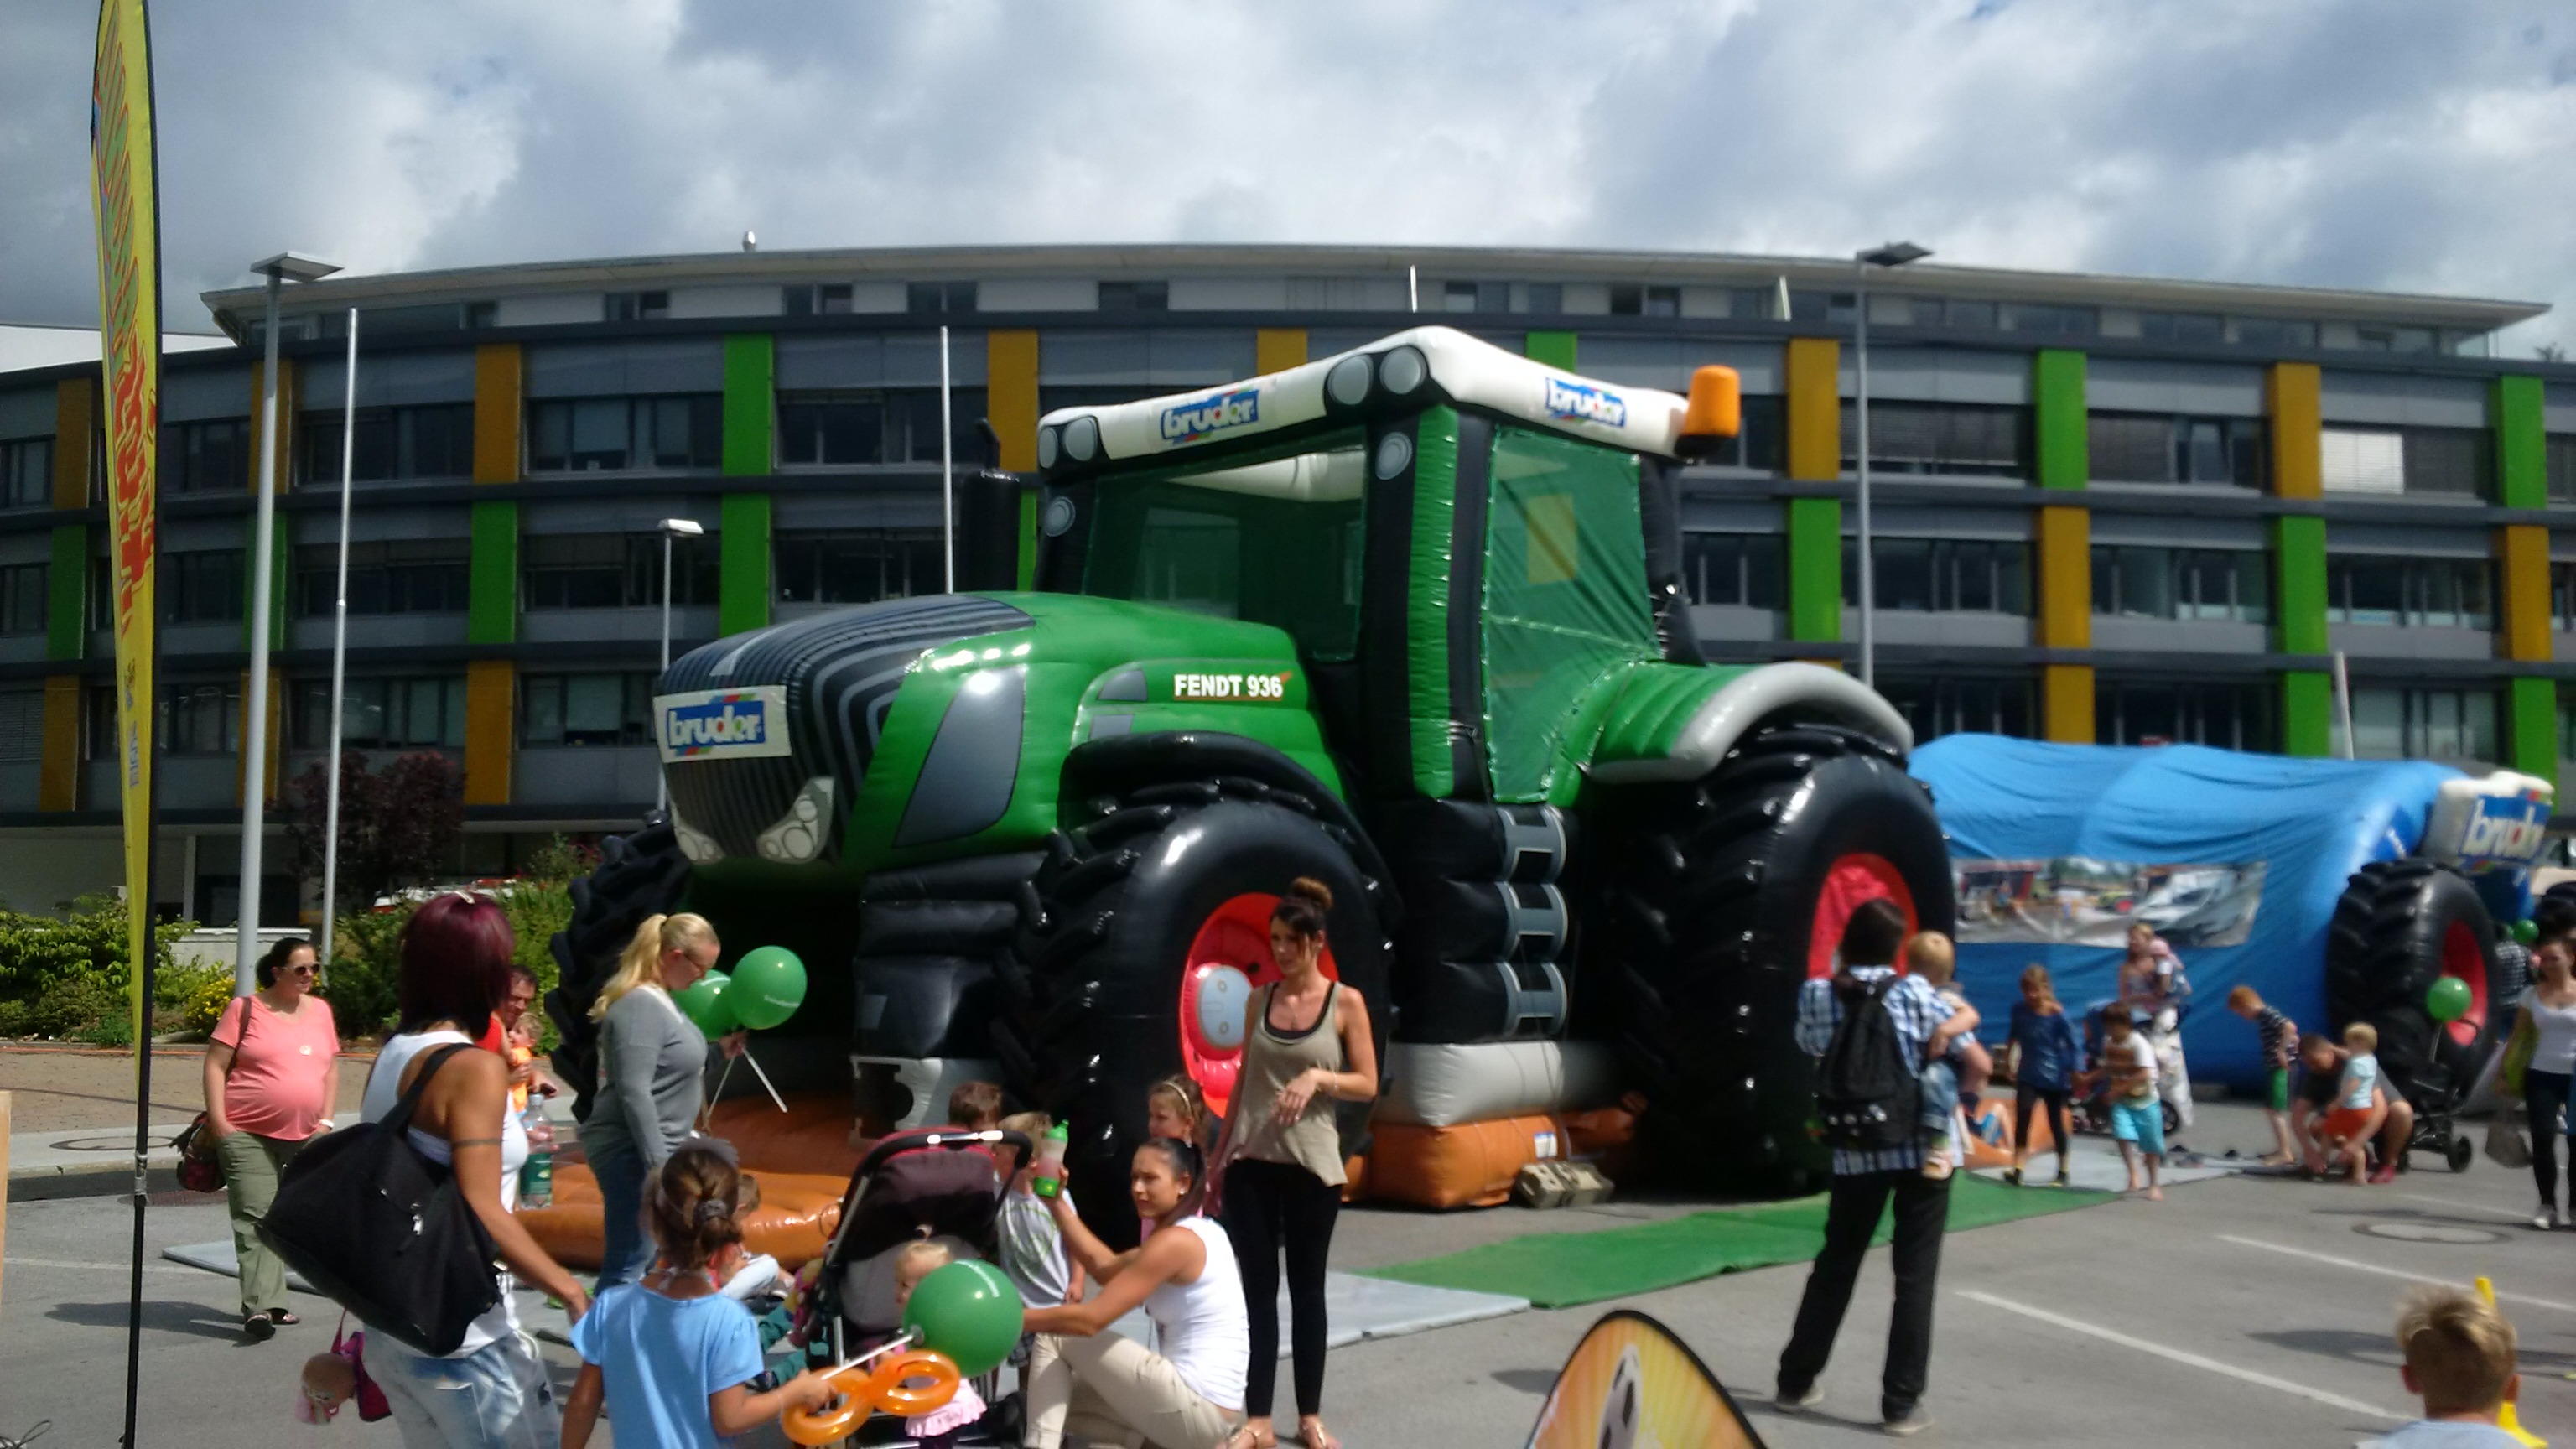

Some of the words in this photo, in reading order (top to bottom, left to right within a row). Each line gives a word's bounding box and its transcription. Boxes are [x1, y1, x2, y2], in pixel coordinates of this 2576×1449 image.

[1164, 397, 1255, 439] bruder
[1550, 380, 1622, 426] bruder
[1175, 674, 1242, 697] FENDT
[1247, 674, 1283, 698] 936
[671, 704, 761, 745] bruder
